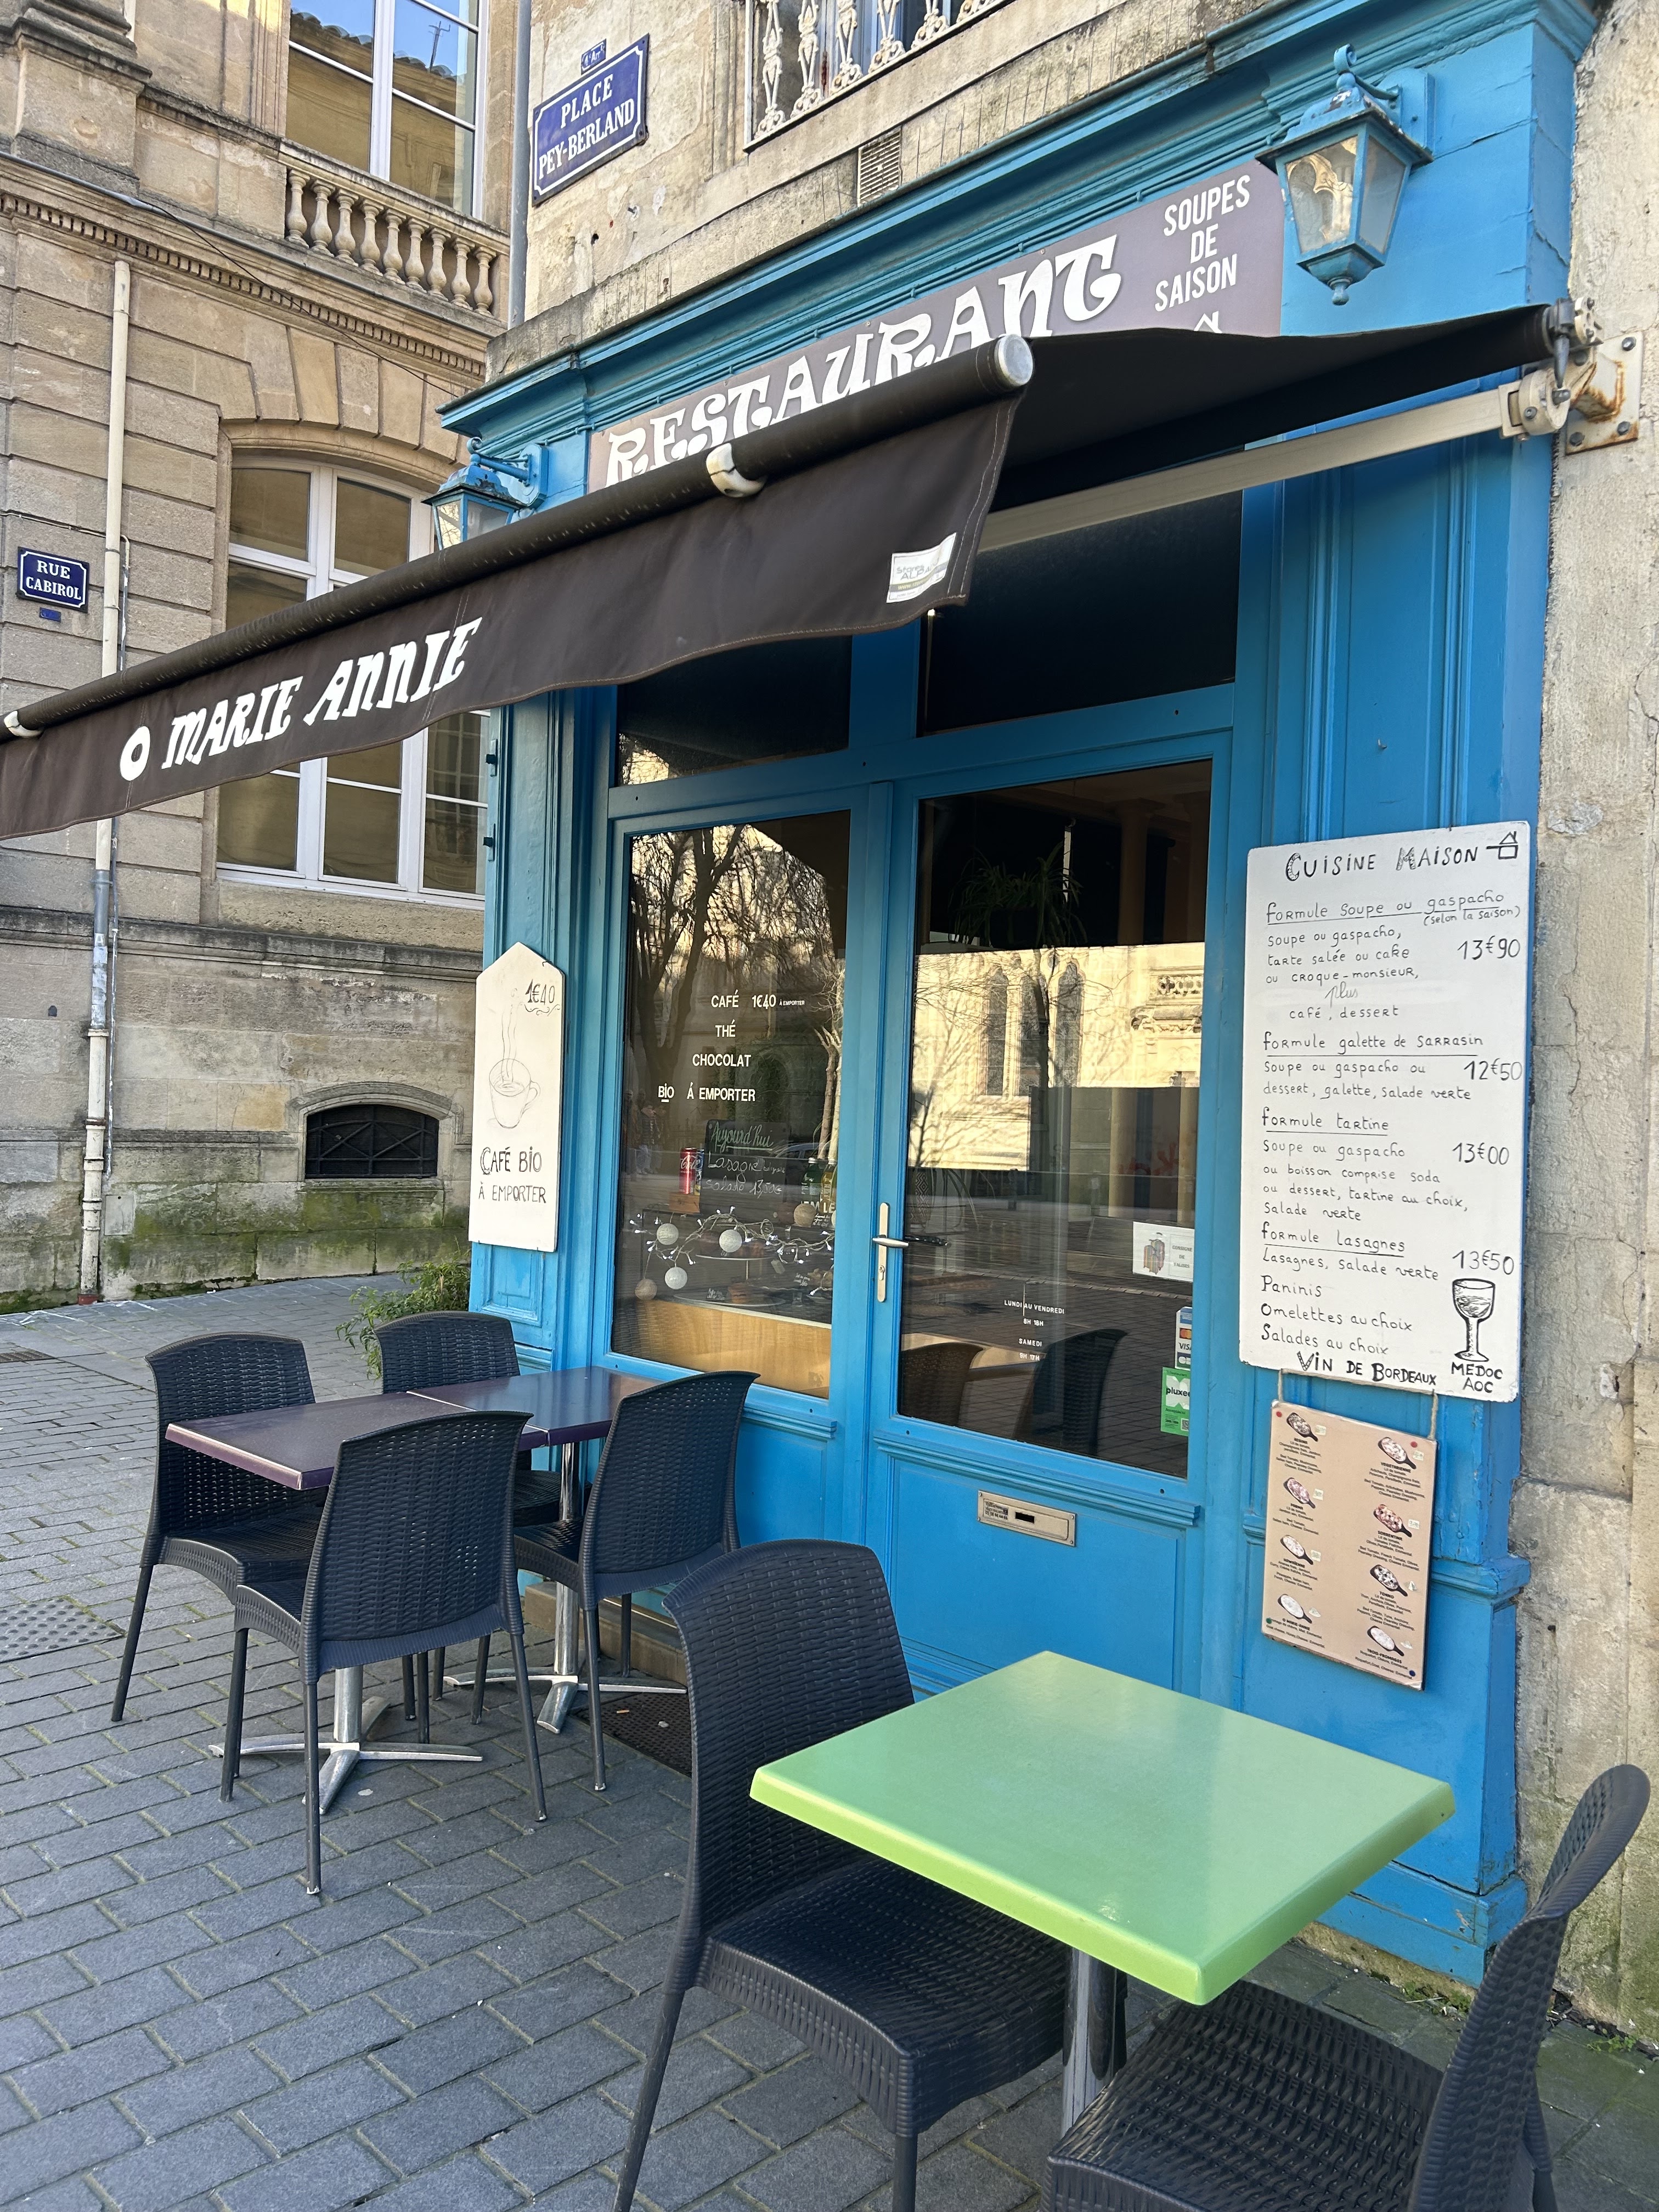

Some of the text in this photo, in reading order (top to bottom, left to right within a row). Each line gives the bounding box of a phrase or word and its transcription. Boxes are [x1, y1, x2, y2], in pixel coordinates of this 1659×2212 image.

[560, 74, 613, 128] PLACE
[539, 98, 634, 180] PEY-BERLAND
[1163, 174, 1251, 236] SOUPES
[1190, 223, 1218, 264] DE
[1154, 253, 1237, 312] SAISON
[605, 234, 1122, 488] RESTAURANT
[37, 560, 70, 579] RUE
[26, 577, 81, 600] CABIROL
[120, 617, 482, 781] O MARIE ANNIE
[1397, 901, 1412, 911] ou
[1427, 890, 1504, 914] gaspacho
[1424, 905, 1521, 926] (selon la saison)
[1330, 925, 1401, 947] gaspacho,
[1312, 949, 1345, 965] salée
[1376, 944, 1409, 960] cake
[711, 990, 739, 1008] CAFÉ
[752, 995, 776, 1009] 1€40
[715, 1019, 736, 1037] THÉ
[1338, 1031, 1386, 1054] galette
[1394, 1034, 1406, 1047] de
[692, 1053, 752, 1067] CHOCOLAT
[1334, 1059, 1398, 1078] gaspacho
[699, 1087, 755, 1102] EMPORTER
[1320, 1082, 1376, 1099] galette,
[1335, 1142, 1405, 1162] gaspacho
[1288, 1163, 1331, 1176] boisson
[492, 1185, 547, 1204] EMPORTER
[1425, 1191, 1468, 1211] choix,
[1260, 1275, 1322, 1297] Paninis
[1034, 1304, 1064, 1314] VENDREDI
[1261, 1303, 1412, 1331] Omelettes au choix
[1019, 1338, 1042, 1347] SAMEDI
[1261, 1323, 1389, 1355] Salades au choix
[1346, 1361, 1363, 1375] DE
[1371, 1363, 1437, 1386] BORDEAUX
[1462, 1377, 1493, 1393] AOC
